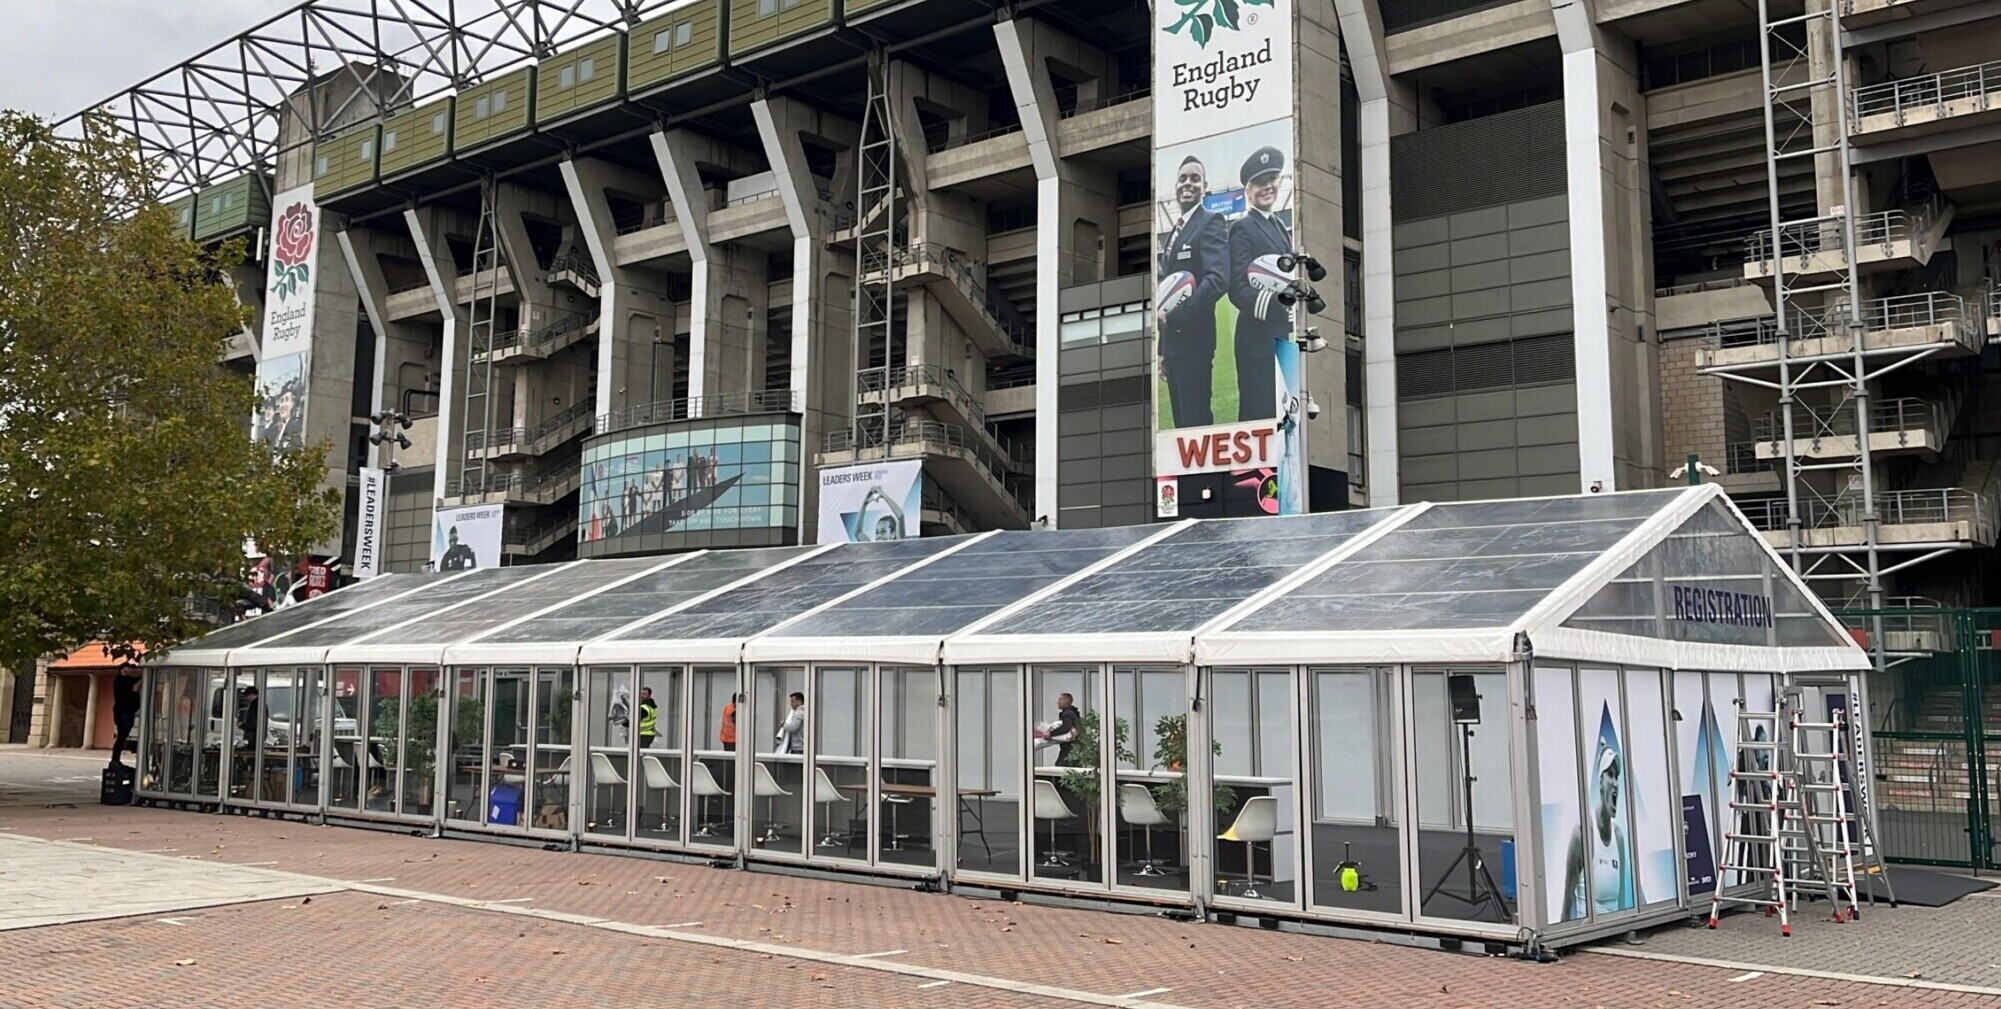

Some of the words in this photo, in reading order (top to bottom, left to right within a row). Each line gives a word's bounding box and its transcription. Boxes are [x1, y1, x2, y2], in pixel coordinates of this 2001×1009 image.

[1172, 37, 1272, 87] England
[1183, 75, 1261, 112] Rugby
[270, 301, 306, 326] England
[272, 322, 301, 342] Rugby
[1177, 428, 1273, 468] WEST
[823, 473, 852, 486] LEADERS
[852, 471, 873, 482] WEEK
[360, 476, 377, 570] #LEADERSWEEK
[456, 512, 476, 521] LEADERS
[476, 510, 490, 519] WEEK
[1674, 586, 1772, 629] REGISTRATION
[1851, 692, 1869, 839] #LEADERSWK
